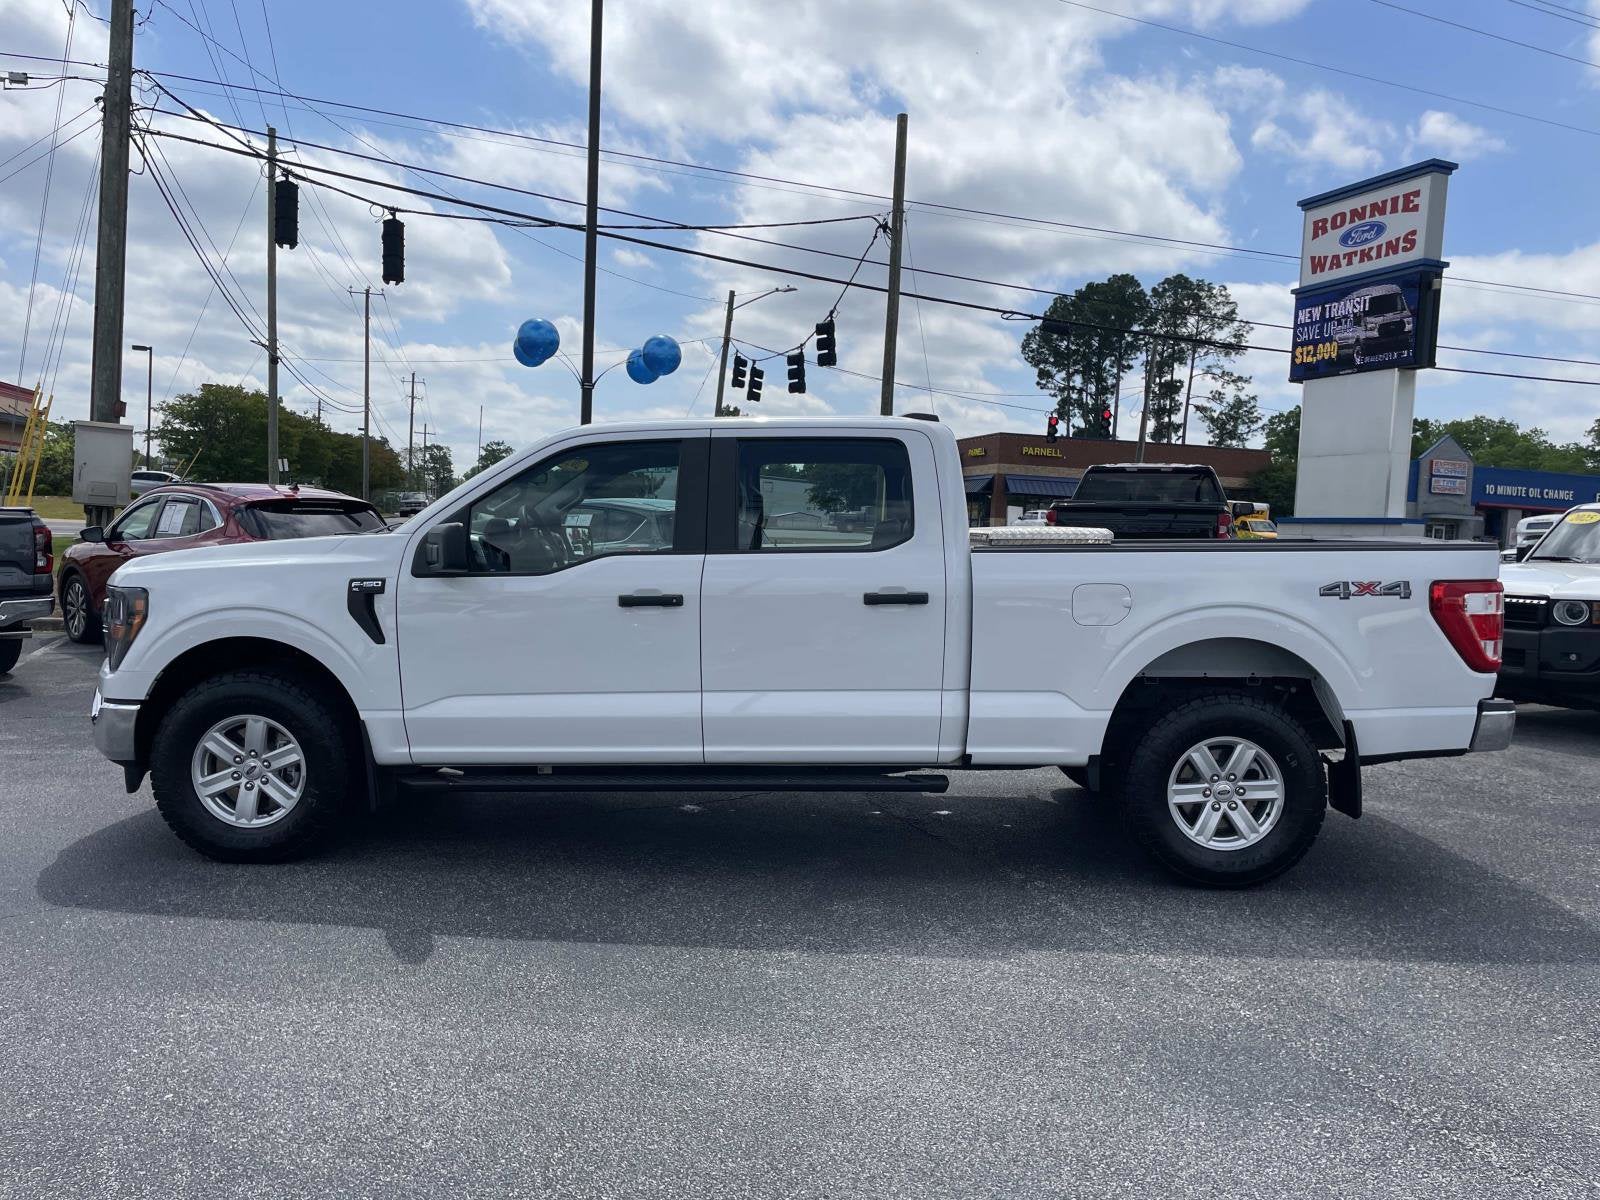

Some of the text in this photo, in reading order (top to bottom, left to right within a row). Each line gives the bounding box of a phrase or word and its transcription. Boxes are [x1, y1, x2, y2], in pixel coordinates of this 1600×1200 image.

[1311, 189, 1421, 241] RONNIE
[1347, 225, 1378, 245] Ford
[1309, 229, 1418, 275] WATKINS
[1297, 295, 1372, 325] NEW TRANSIT
[1296, 323, 1321, 342] SAVE
[1323, 320, 1337, 337] UP
[1295, 341, 1338, 365] $12,000
[1022, 446, 1062, 457] PARNELL
[1485, 484, 1495, 494] 10
[1496, 485, 1527, 497] MINUTE
[1528, 487, 1541, 498] OIL
[1543, 488, 1574, 501] CHANGE
